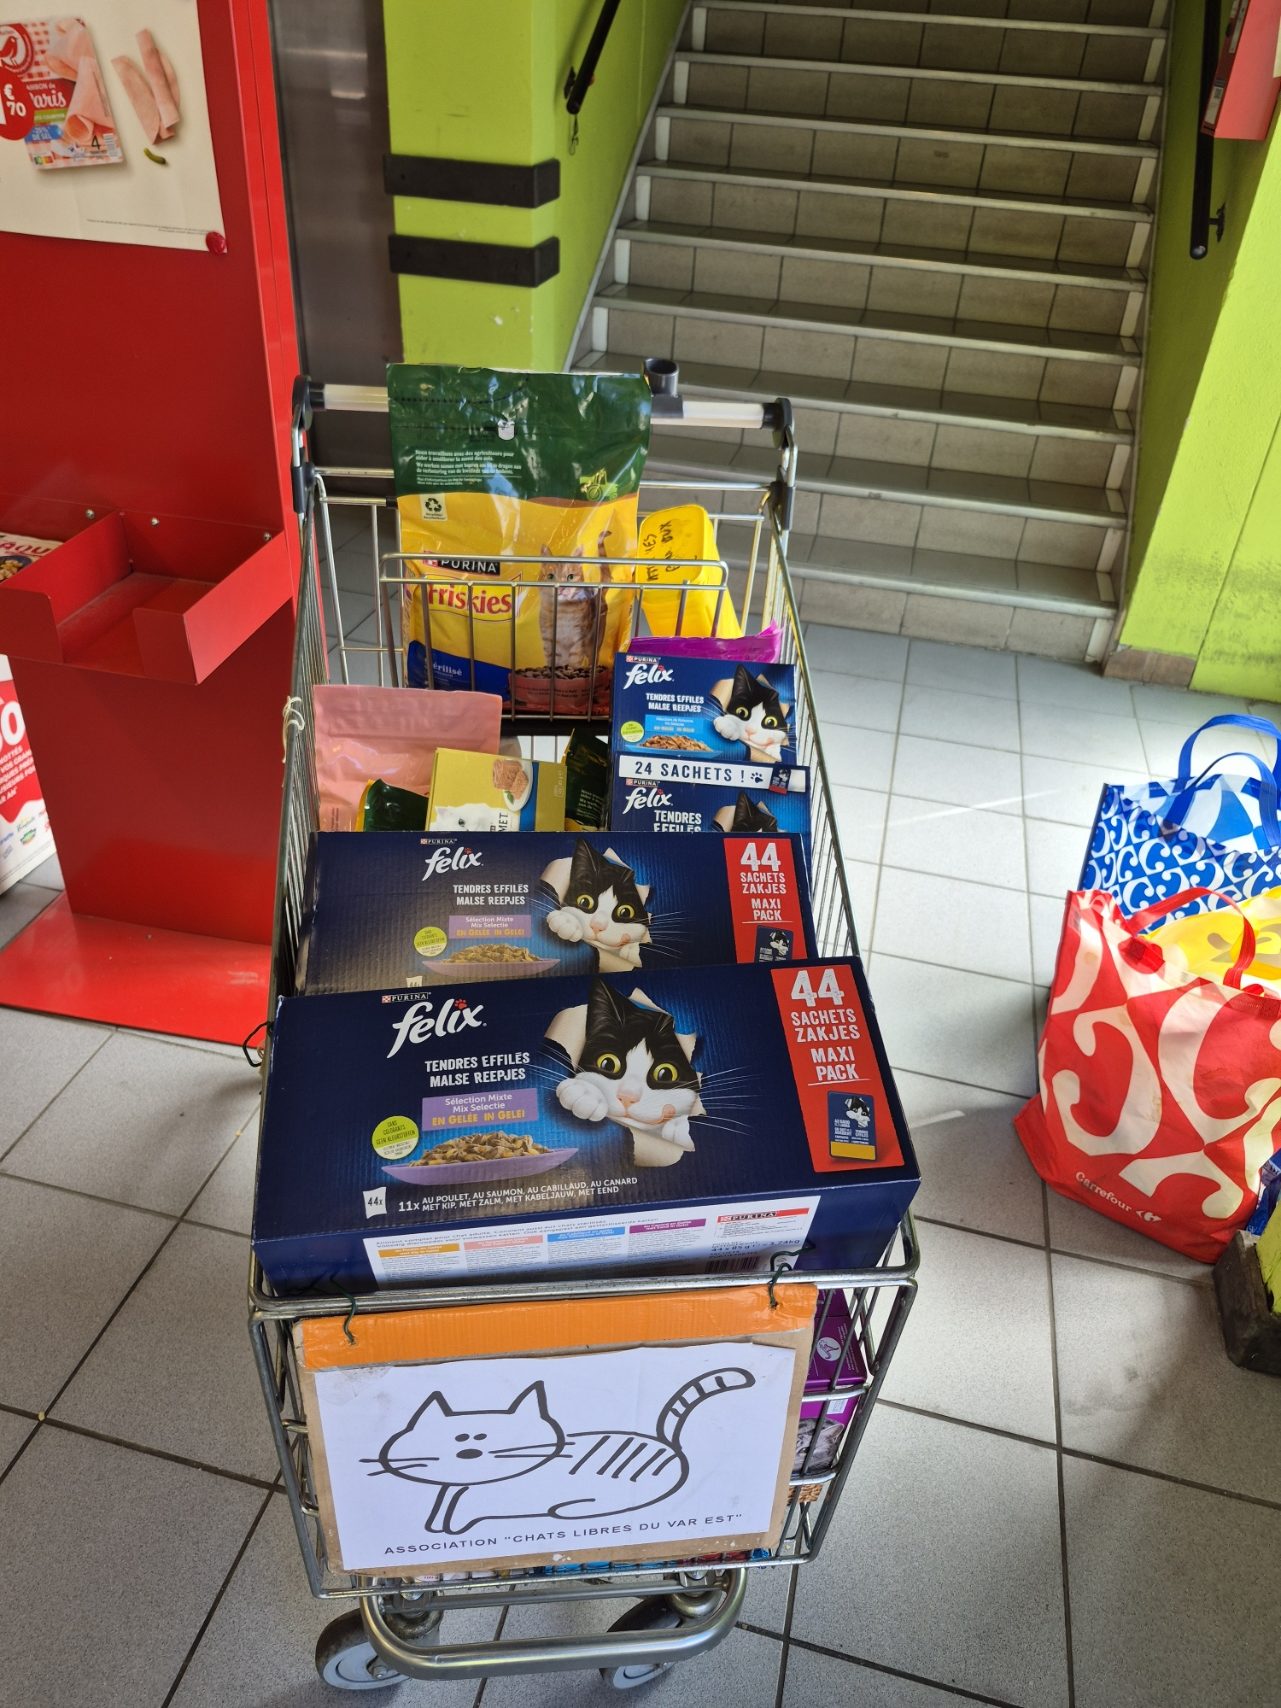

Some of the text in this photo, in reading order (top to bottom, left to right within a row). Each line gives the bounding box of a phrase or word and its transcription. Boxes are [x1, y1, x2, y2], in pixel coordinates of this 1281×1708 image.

[29, 90, 66, 108] aris
[6, 101, 26, 117] 70
[91, 135, 102, 150] 4
[441, 560, 497, 573] PURINA
[431, 661, 462, 676] érilisé
[623, 663, 673, 689] felix
[645, 692, 675, 702] TENDRES
[648, 702, 702, 713] MALSE REEPJES
[635, 761, 744, 783] 24 SACHETS !
[622, 788, 672, 814] felix
[654, 810, 702, 824] TENDRES
[422, 847, 483, 881] felix
[740, 842, 782, 872] 44
[740, 872, 785, 883] SACHETS
[453, 884, 491, 894] TENDRES
[742, 883, 787, 894] ZAKJES
[456, 895, 525, 906] MALSE REEPJES
[751, 898, 781, 909] MAXI
[753, 910, 782, 921] PACK
[791, 968, 845, 1007] 44
[391, 993, 427, 1002] PURINA
[791, 1008, 857, 1027] SACHETS
[387, 998, 484, 1059] felix
[795, 1024, 861, 1043] ZAKJES
[810, 1046, 855, 1064] MAXI
[425, 1056, 478, 1073] TENDRES
[816, 1063, 860, 1081] PACK
[430, 1068, 526, 1088] MALSE REEPJES
[445, 1093, 512, 1106] Sélection Mixte
[453, 1102, 505, 1113] Mix Selectie
[432, 1116, 445, 1126] EN
[484, 1111, 495, 1121] IN
[422, 1196, 434, 1204] AU
[436, 1193, 471, 1203] POULET,
[473, 1191, 485, 1199] AU
[486, 1188, 525, 1198] SAUMON,
[590, 1180, 602, 1188] AU
[604, 1177, 638, 1187] CANARD
[422, 1203, 439, 1211] MET
[459, 1199, 477, 1208] MET
[479, 1197, 503, 1207] ZALM,
[506, 1195, 522, 1203] MET
[578, 1187, 595, 1196] MET
[598, 1185, 619, 1195] EEND
[1075, 1171, 1133, 1213] Carrefour
[367, 1196, 383, 1207] 44x
[398, 1200, 420, 1212] 11x
[731, 1211, 775, 1221] PURINA
[384, 1513, 742, 1555] ASSOCIATION "CHATS LIBRES DU VAR EST"
